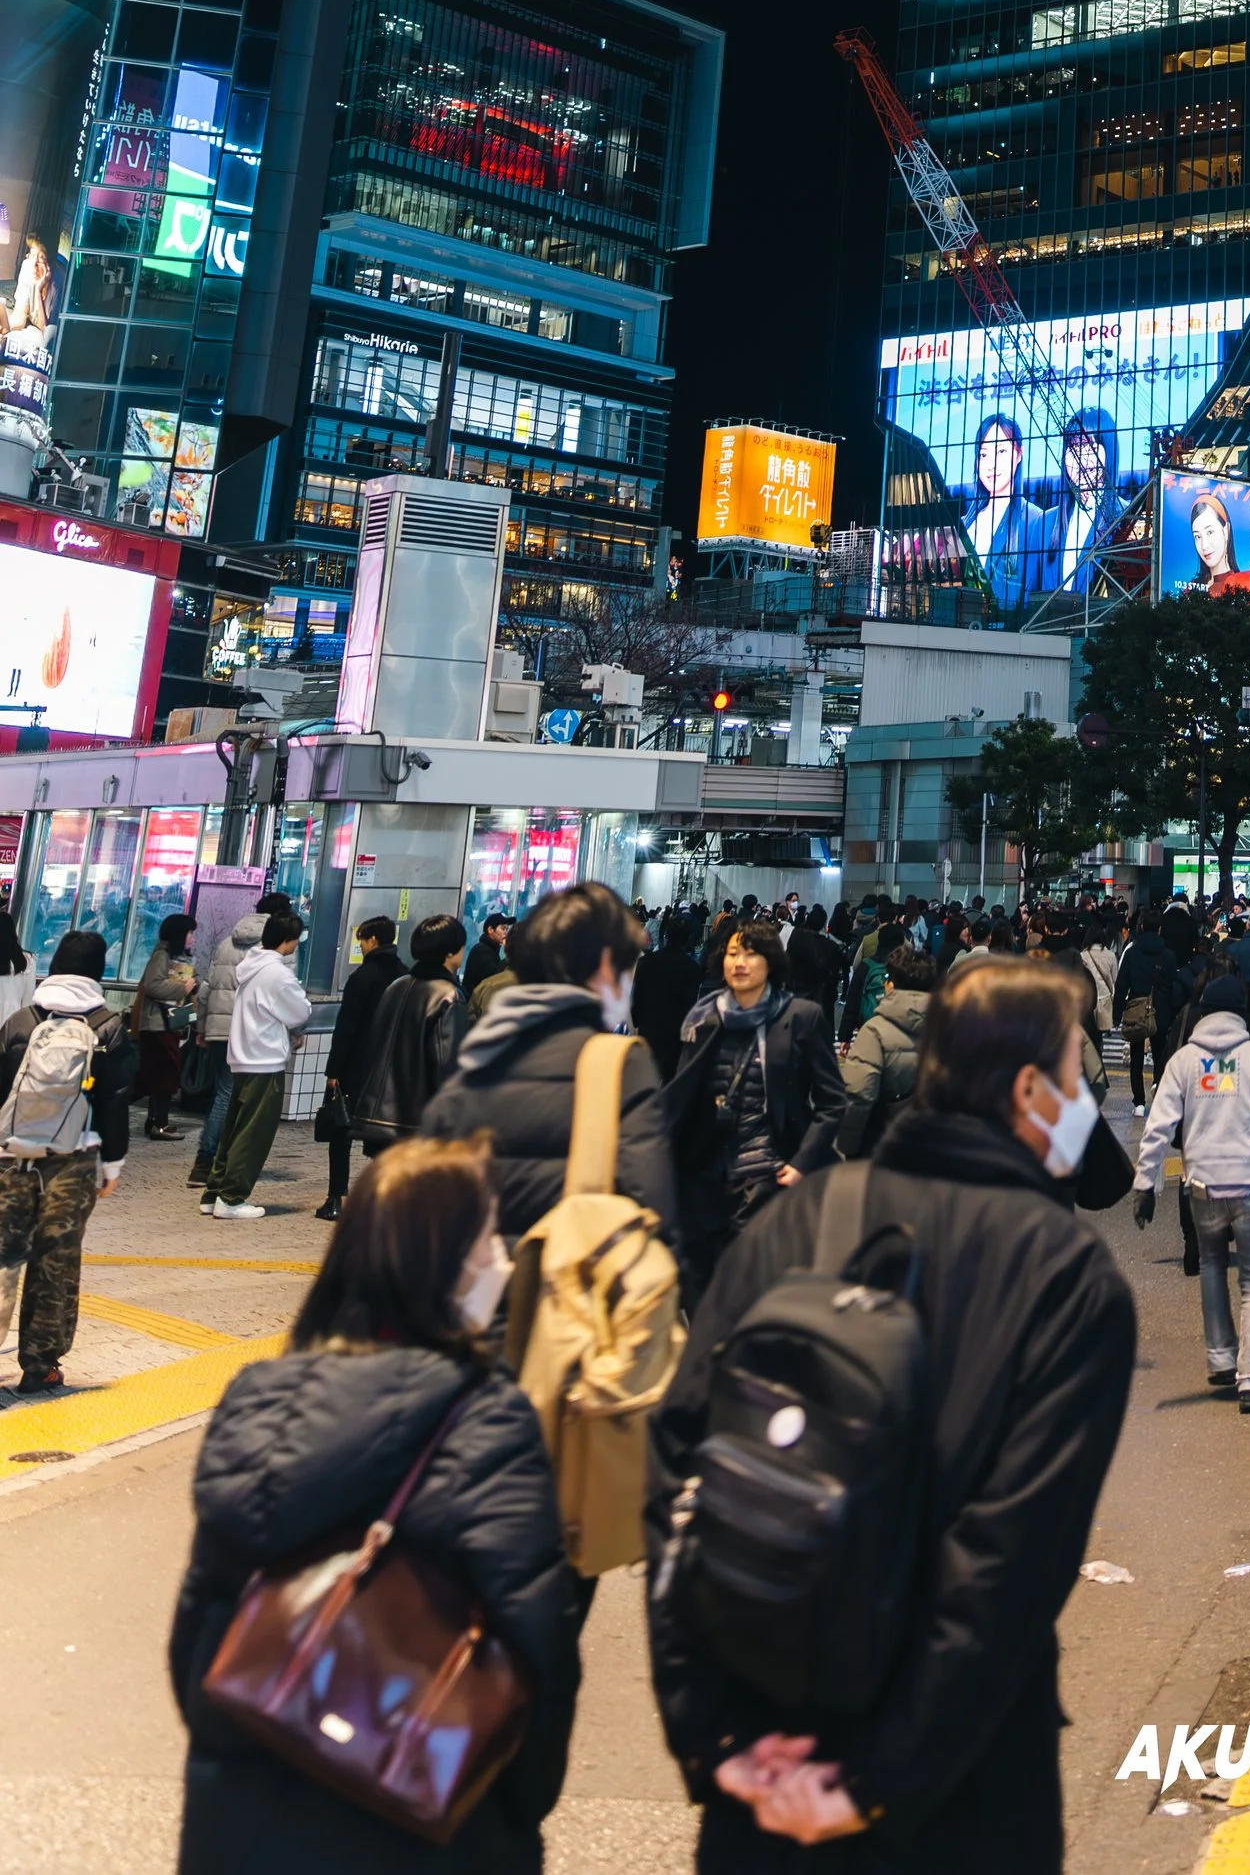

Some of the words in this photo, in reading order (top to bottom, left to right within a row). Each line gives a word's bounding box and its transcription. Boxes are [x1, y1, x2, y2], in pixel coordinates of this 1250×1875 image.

[344, 333, 370, 345] Shibuya
[369, 332, 419, 354] Hikarie
[767, 454, 811, 488] 龍角散
[760, 484, 817, 519] ダイレクト
[53, 520, 100, 552] Glico
[1174, 581, 1188, 590] 10.3
[1188, 582, 1210, 592] START
[212, 649, 246, 666] COFFEE
